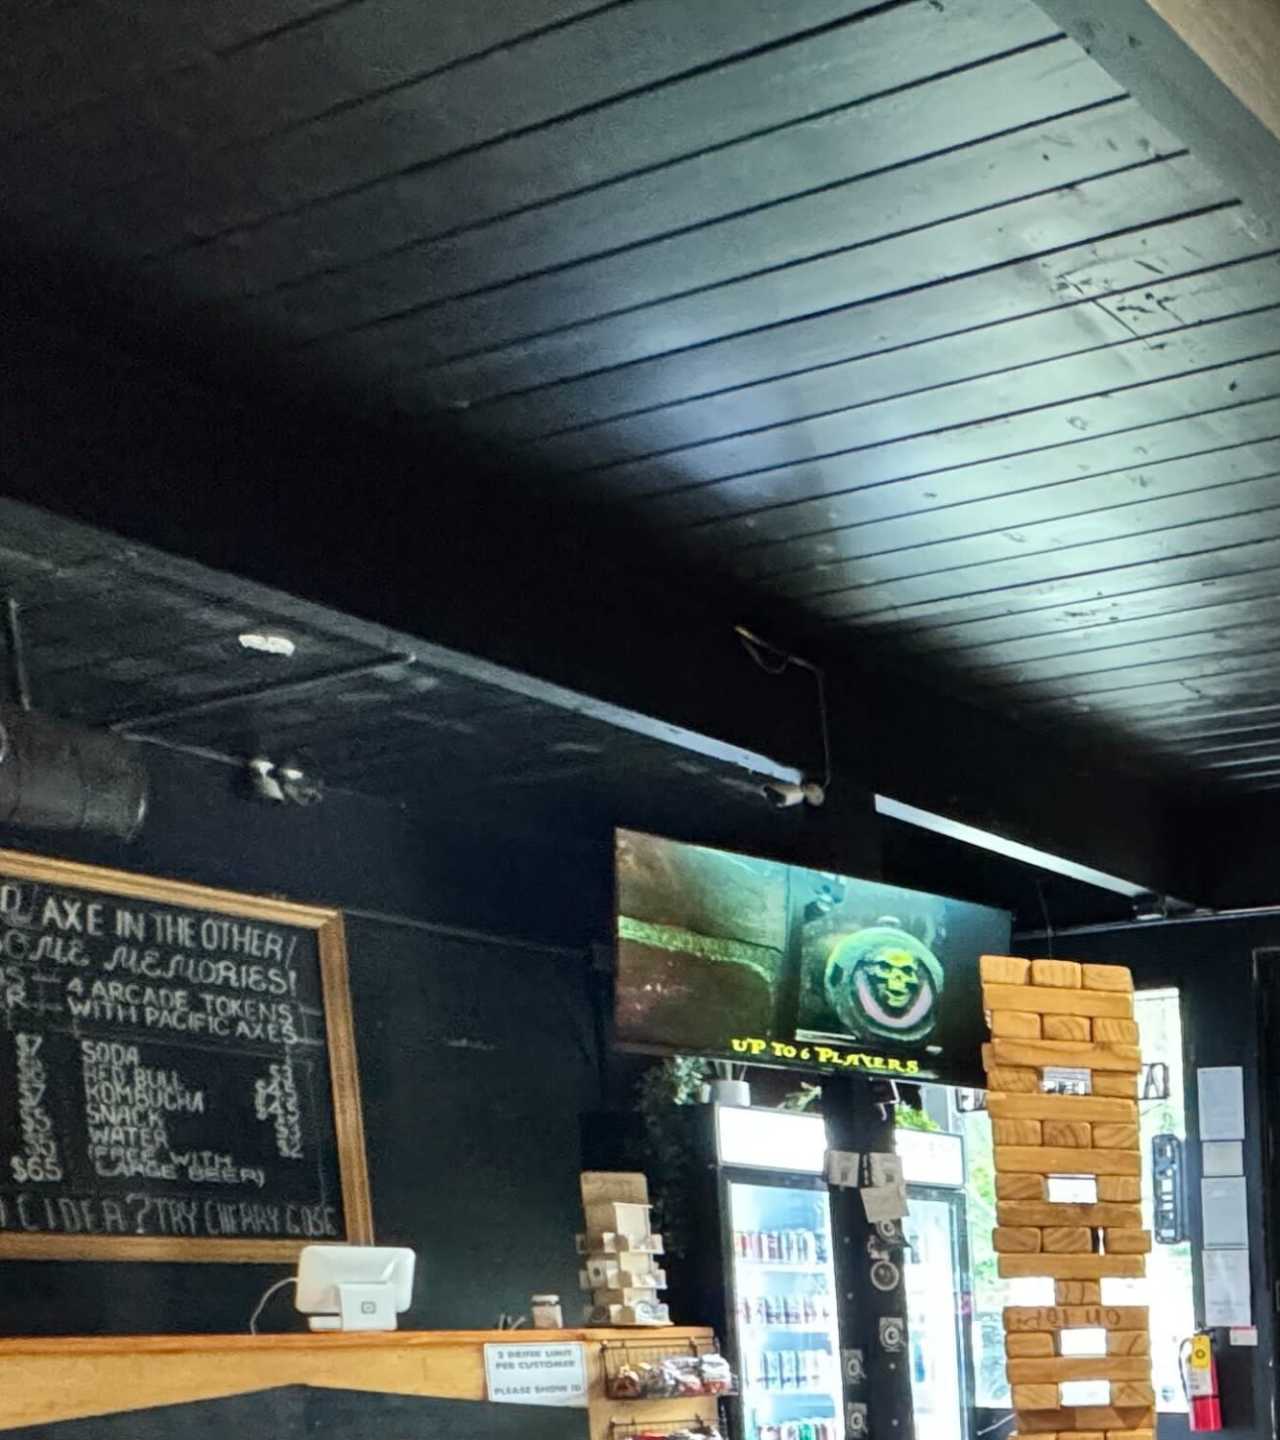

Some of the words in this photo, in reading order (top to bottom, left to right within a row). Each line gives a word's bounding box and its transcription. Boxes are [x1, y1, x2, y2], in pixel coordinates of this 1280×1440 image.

[42, 896, 103, 936] AXE
[115, 910, 145, 941] IN
[153, 913, 196, 947] THE
[91, 981, 189, 1012] ARCADE
[203, 994, 293, 1023] TOKENS
[67, 996, 137, 1023] WITH
[145, 1007, 229, 1036] PACIFIC
[235, 1021, 299, 1045] AXES
[82, 1041, 139, 1065] SODA
[731, 1038, 767, 1054] UP
[771, 1042, 797, 1058] TO
[800, 1048, 811, 1060] 6
[814, 1046, 920, 1074] PLAYERS
[85, 1081, 204, 1113] KOMBUCHA
[86, 1103, 164, 1128] SNACK
[89, 1126, 168, 1149] WATER
[10, 1156, 62, 1183] $65
[156, 1198, 198, 1235] TRY
